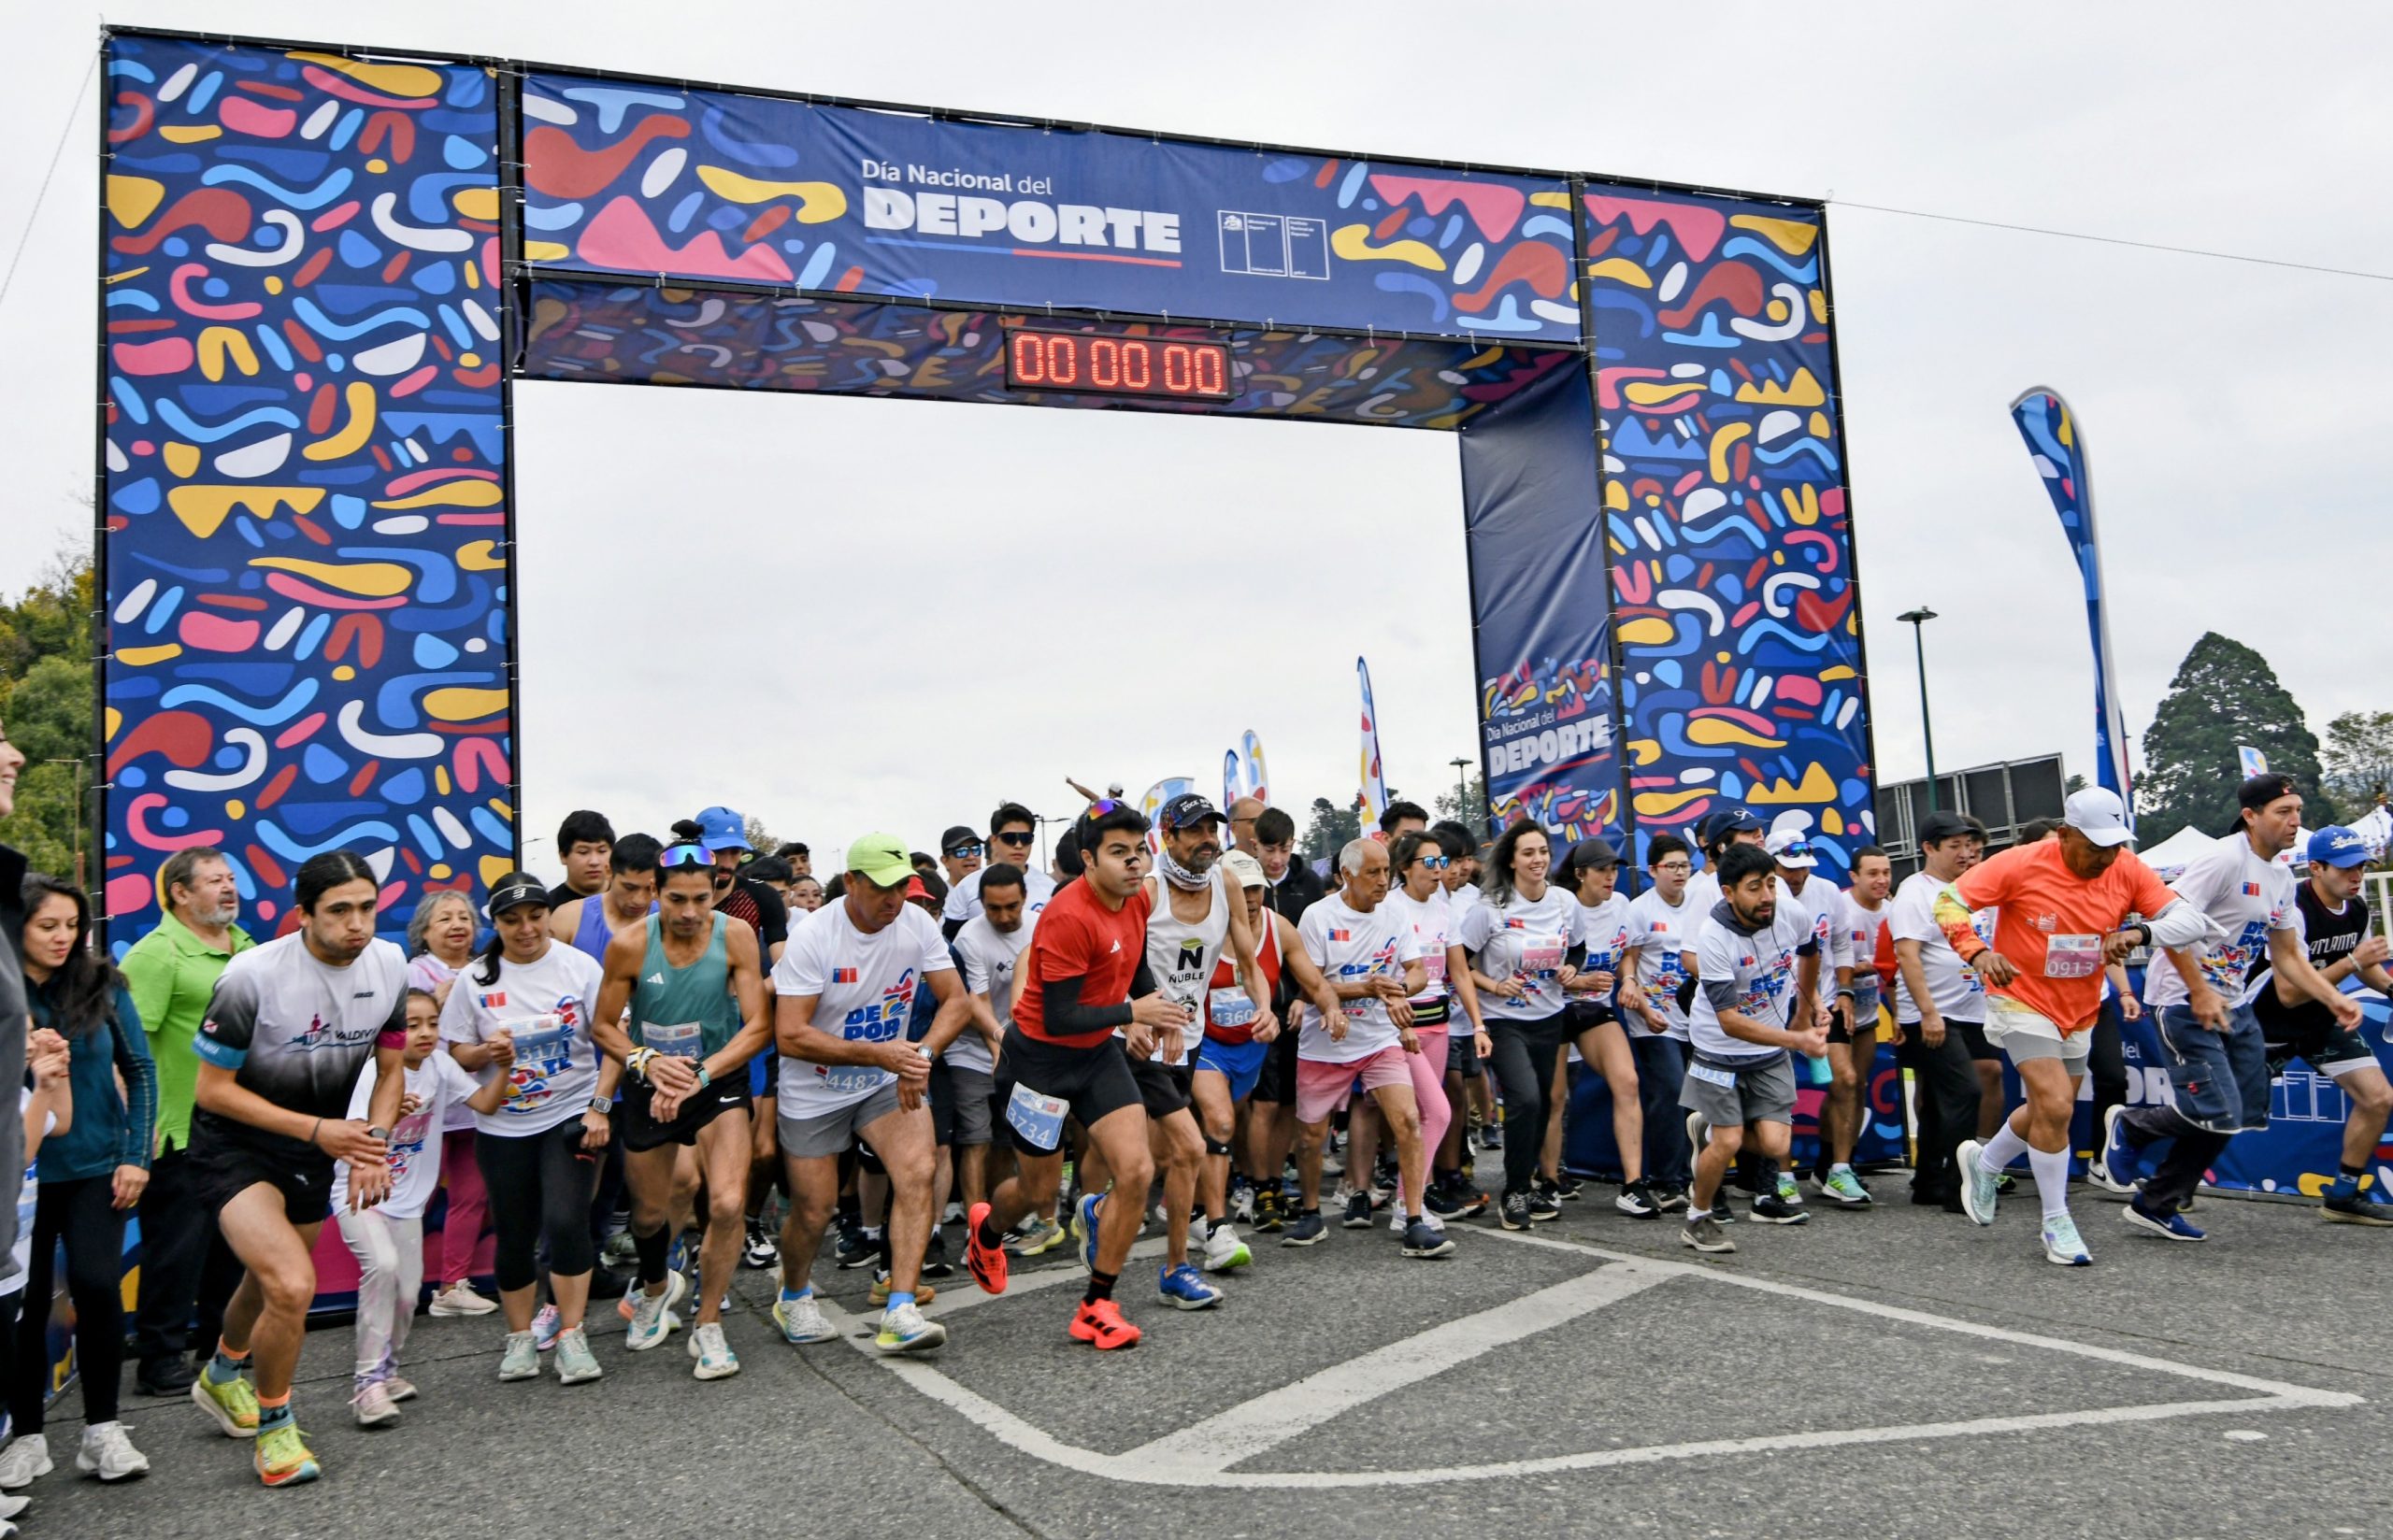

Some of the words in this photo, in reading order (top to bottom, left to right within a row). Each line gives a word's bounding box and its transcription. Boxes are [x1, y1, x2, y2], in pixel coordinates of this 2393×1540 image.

[862, 159, 901, 182] Día
[908, 164, 1012, 192] Nacional
[1017, 176, 1053, 195] del
[864, 186, 1182, 253] DEPORTE
[1501, 713, 1540, 737] Nacional
[1540, 708, 1555, 725] del
[1488, 713, 1612, 777] DEPORTE
[2309, 932, 2358, 955] ATLANTA
[1168, 971, 1205, 984] ÑUBLE
[2046, 961, 2094, 977] 0913
[846, 1004, 881, 1025] DE
[1212, 1008, 1254, 1026] 4360
[520, 1041, 560, 1062] 317
[827, 1073, 879, 1091] 4482
[1009, 1106, 1051, 1146] 3734
